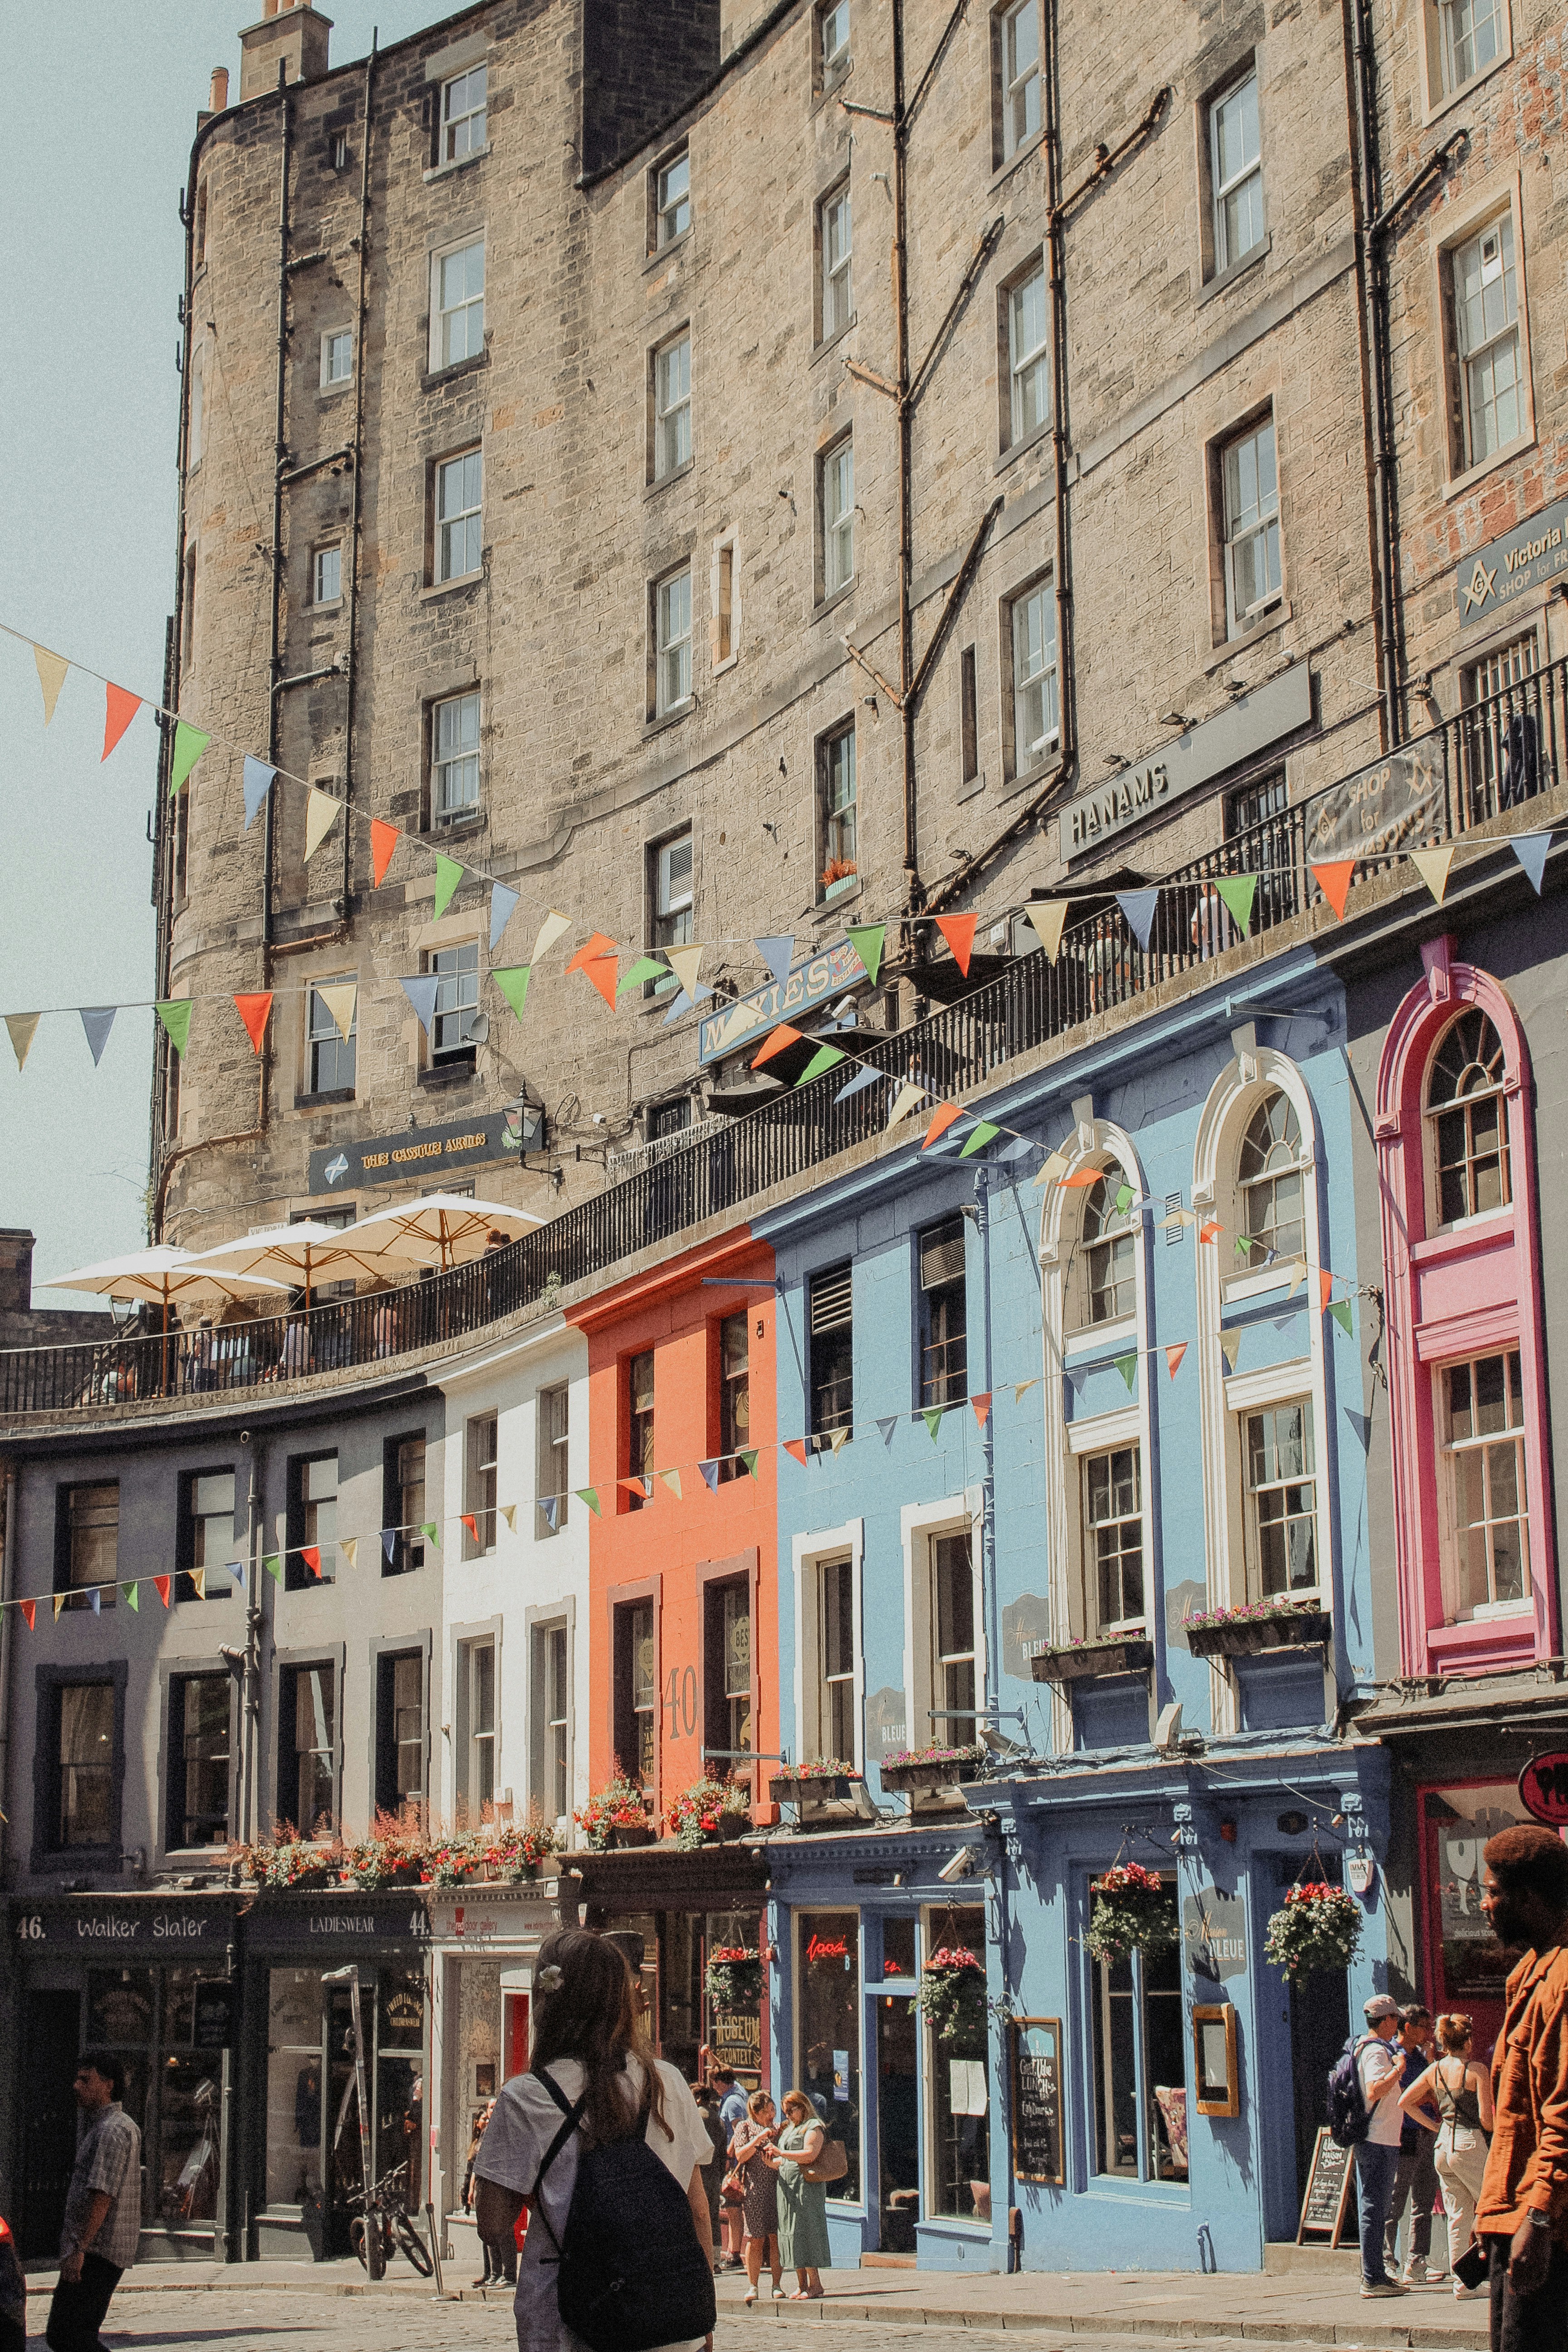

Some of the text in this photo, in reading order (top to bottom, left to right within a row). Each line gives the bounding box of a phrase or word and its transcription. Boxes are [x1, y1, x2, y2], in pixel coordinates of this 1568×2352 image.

[1504, 528, 1562, 573] Victoria
[1499, 545, 1568, 600] SHOP for FR
[1348, 767, 1391, 808] SHOP
[1072, 761, 1168, 843] HANAMS
[1361, 808, 1380, 833] for
[831, 947, 847, 962] BISTRO
[704, 955, 830, 1053] MXIES
[361, 1132, 486, 1169] THE CASTLE ARMS
[736, 1628, 750, 1647] BES
[1022, 1638, 1050, 1660] BLE
[663, 1665, 697, 1740] 40
[882, 1724, 906, 1742] BLEUE
[16, 1915, 207, 1939] 46. Walker Slater
[310, 1911, 429, 1936] LADIESWEAR 44.
[806, 1934, 848, 1962] food
[1209, 1938, 1246, 1960] BLEUE
[716, 2015, 760, 2048] MUSEUM
[725, 2048, 752, 2064] CONTEXT
